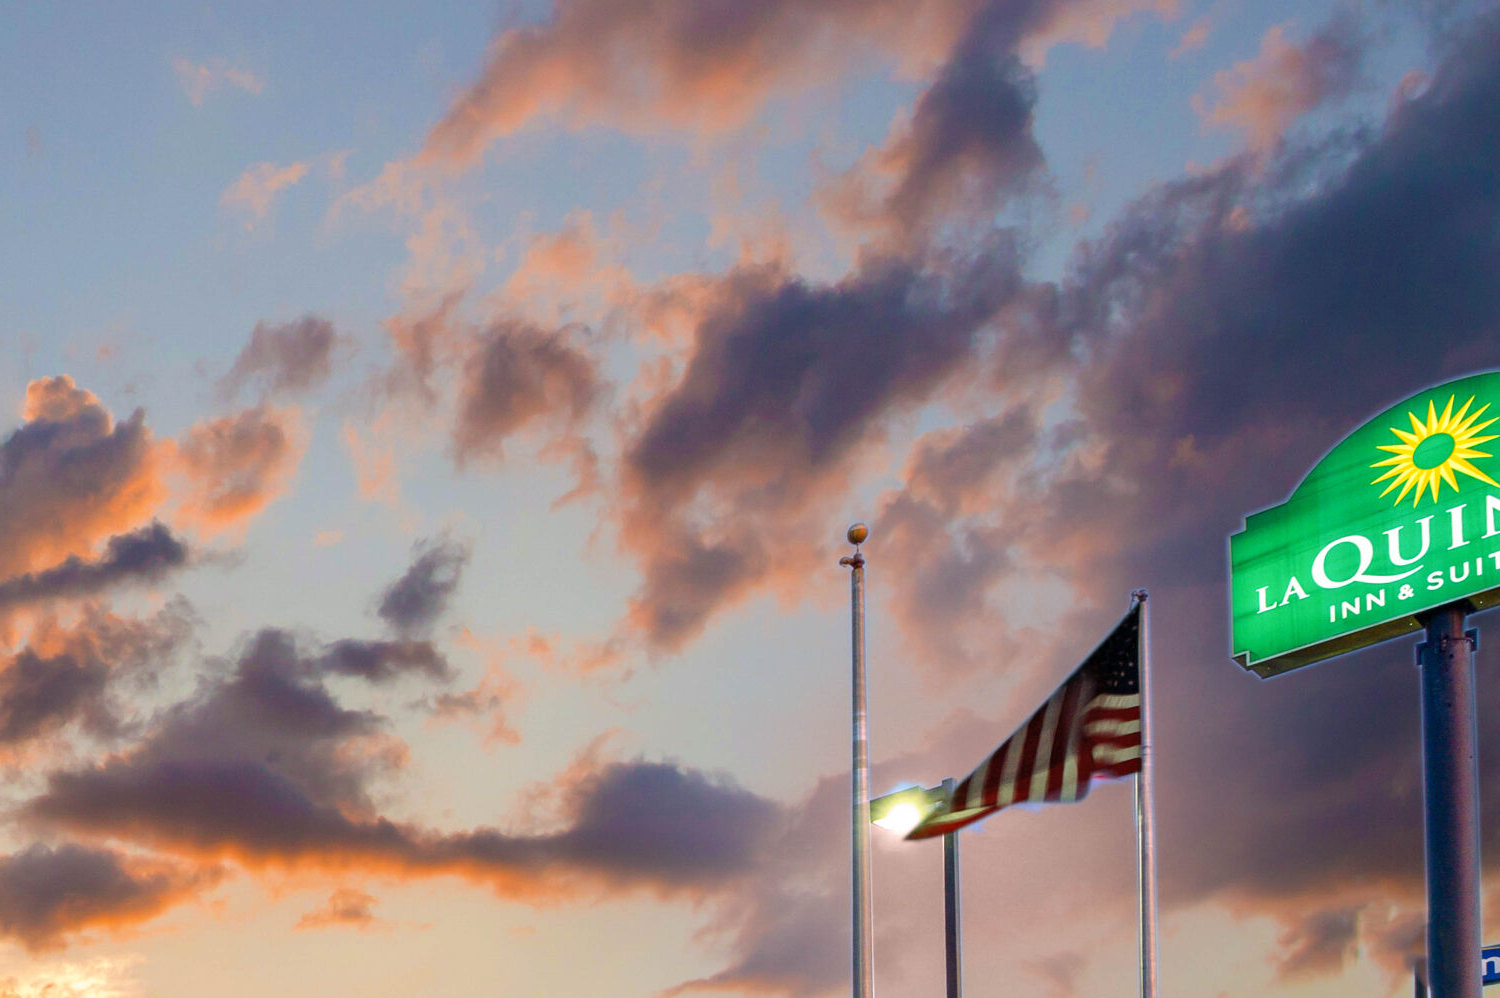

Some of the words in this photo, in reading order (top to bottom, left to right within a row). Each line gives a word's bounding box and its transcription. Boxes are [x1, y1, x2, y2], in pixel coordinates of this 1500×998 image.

[1256, 576, 1310, 614] LA
[1330, 589, 1385, 622] INN
[1398, 584, 1414, 600] &
